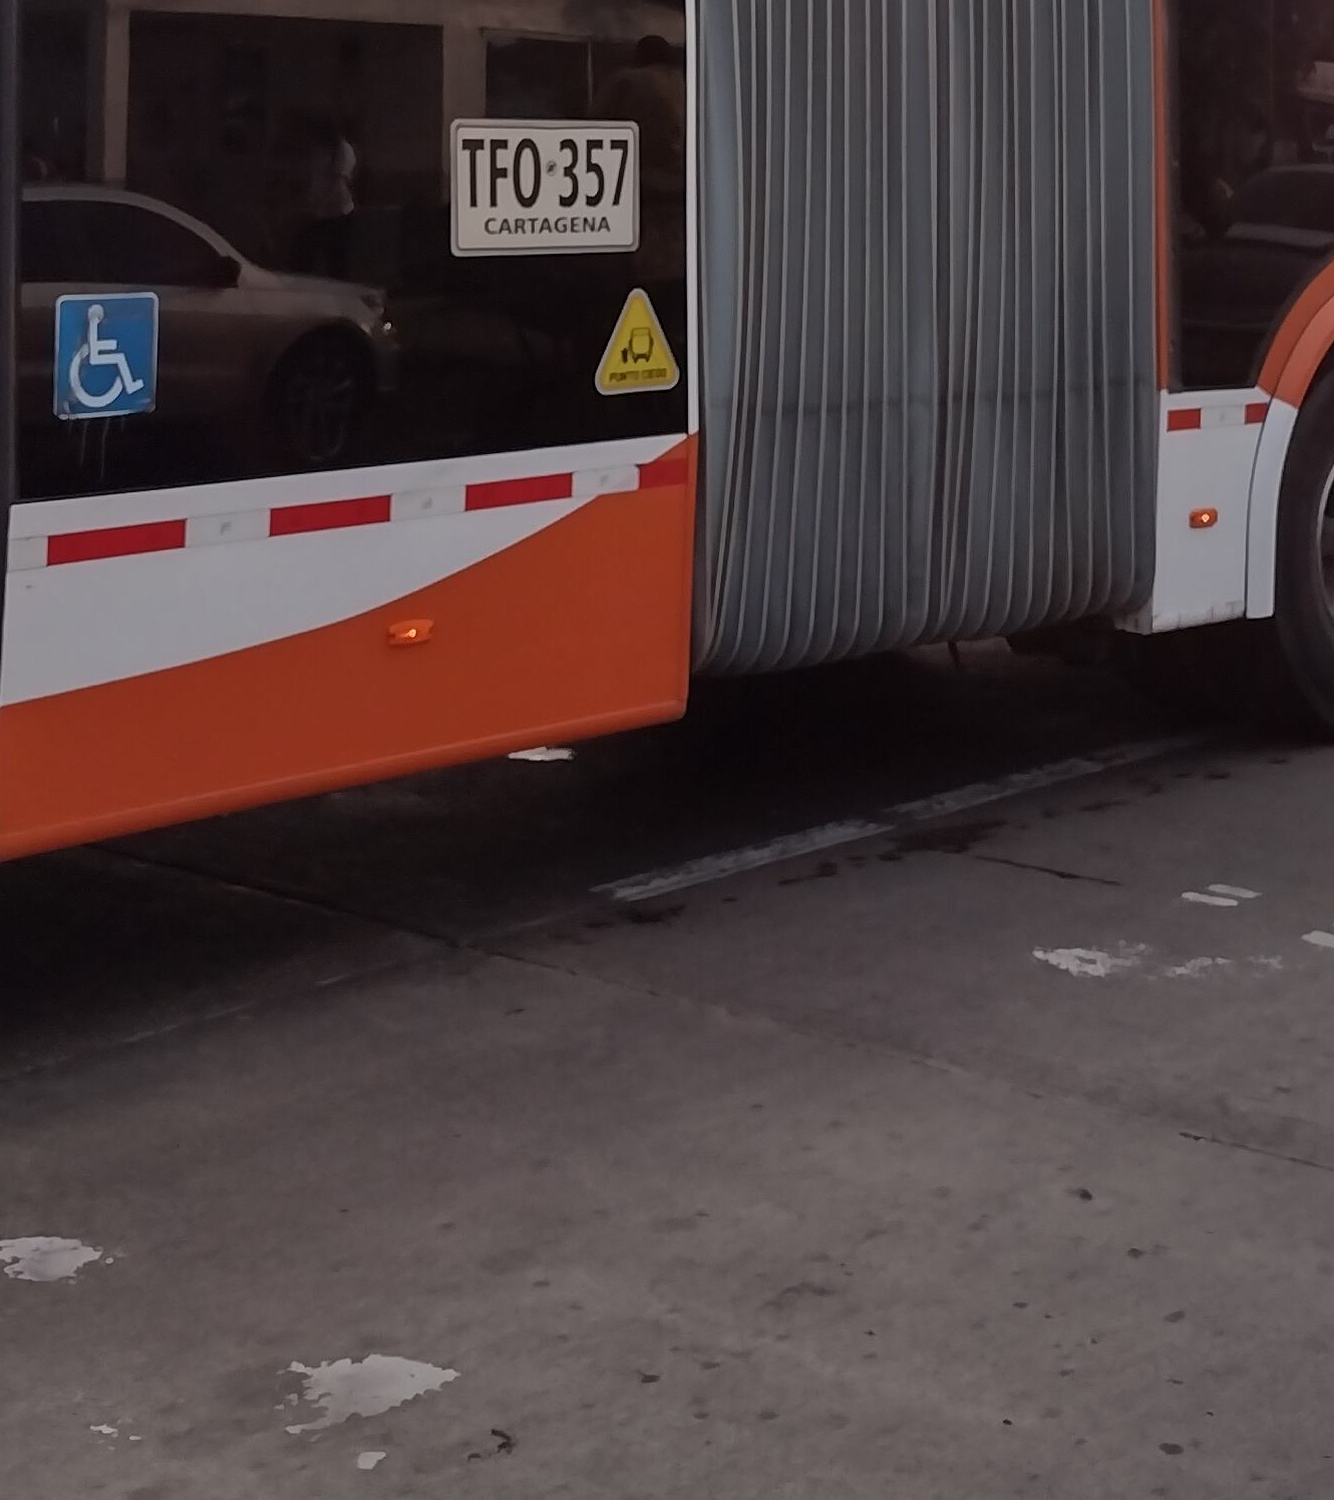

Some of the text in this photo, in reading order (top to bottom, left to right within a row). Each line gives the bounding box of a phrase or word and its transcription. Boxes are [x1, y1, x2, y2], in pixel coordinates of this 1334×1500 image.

[462, 137, 629, 208] TFO 357
[483, 216, 611, 236] CARTAGENA
